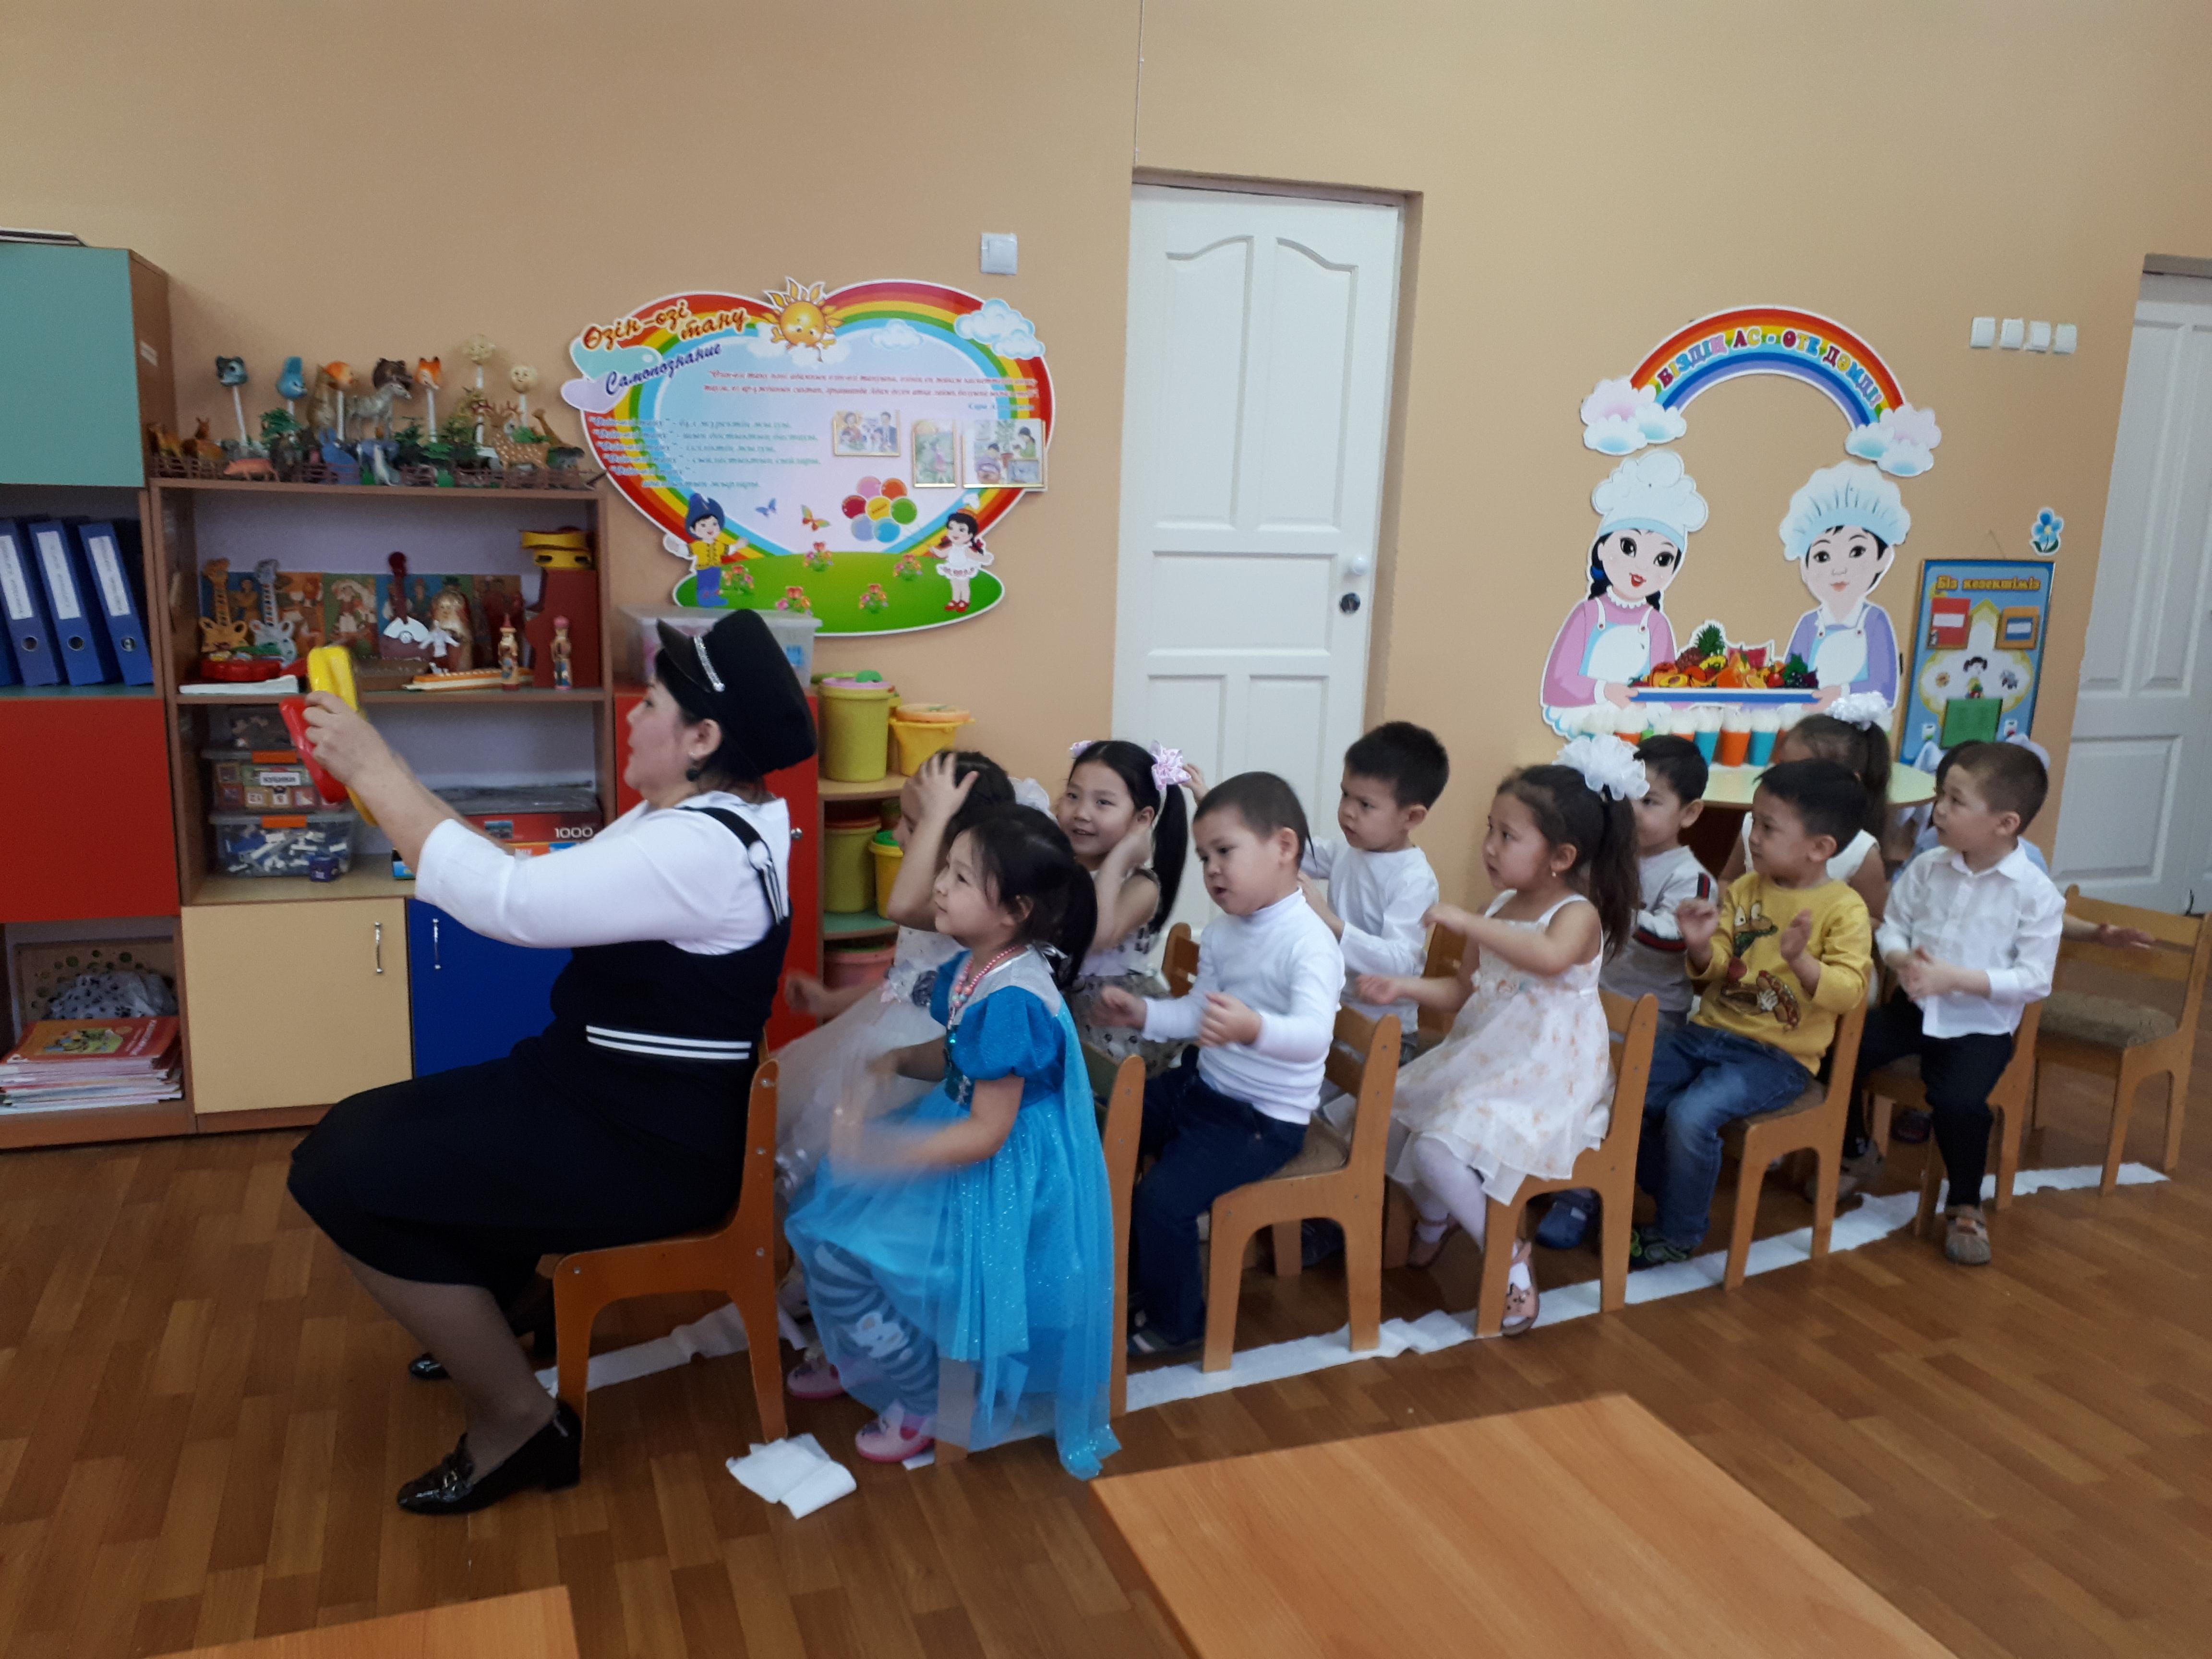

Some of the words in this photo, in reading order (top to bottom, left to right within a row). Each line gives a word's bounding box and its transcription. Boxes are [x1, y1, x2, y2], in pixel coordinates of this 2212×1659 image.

[1732, 329, 1761, 349] АС
[605, 342, 722, 395] Самопознание
[555, 827, 593, 839] 1000
